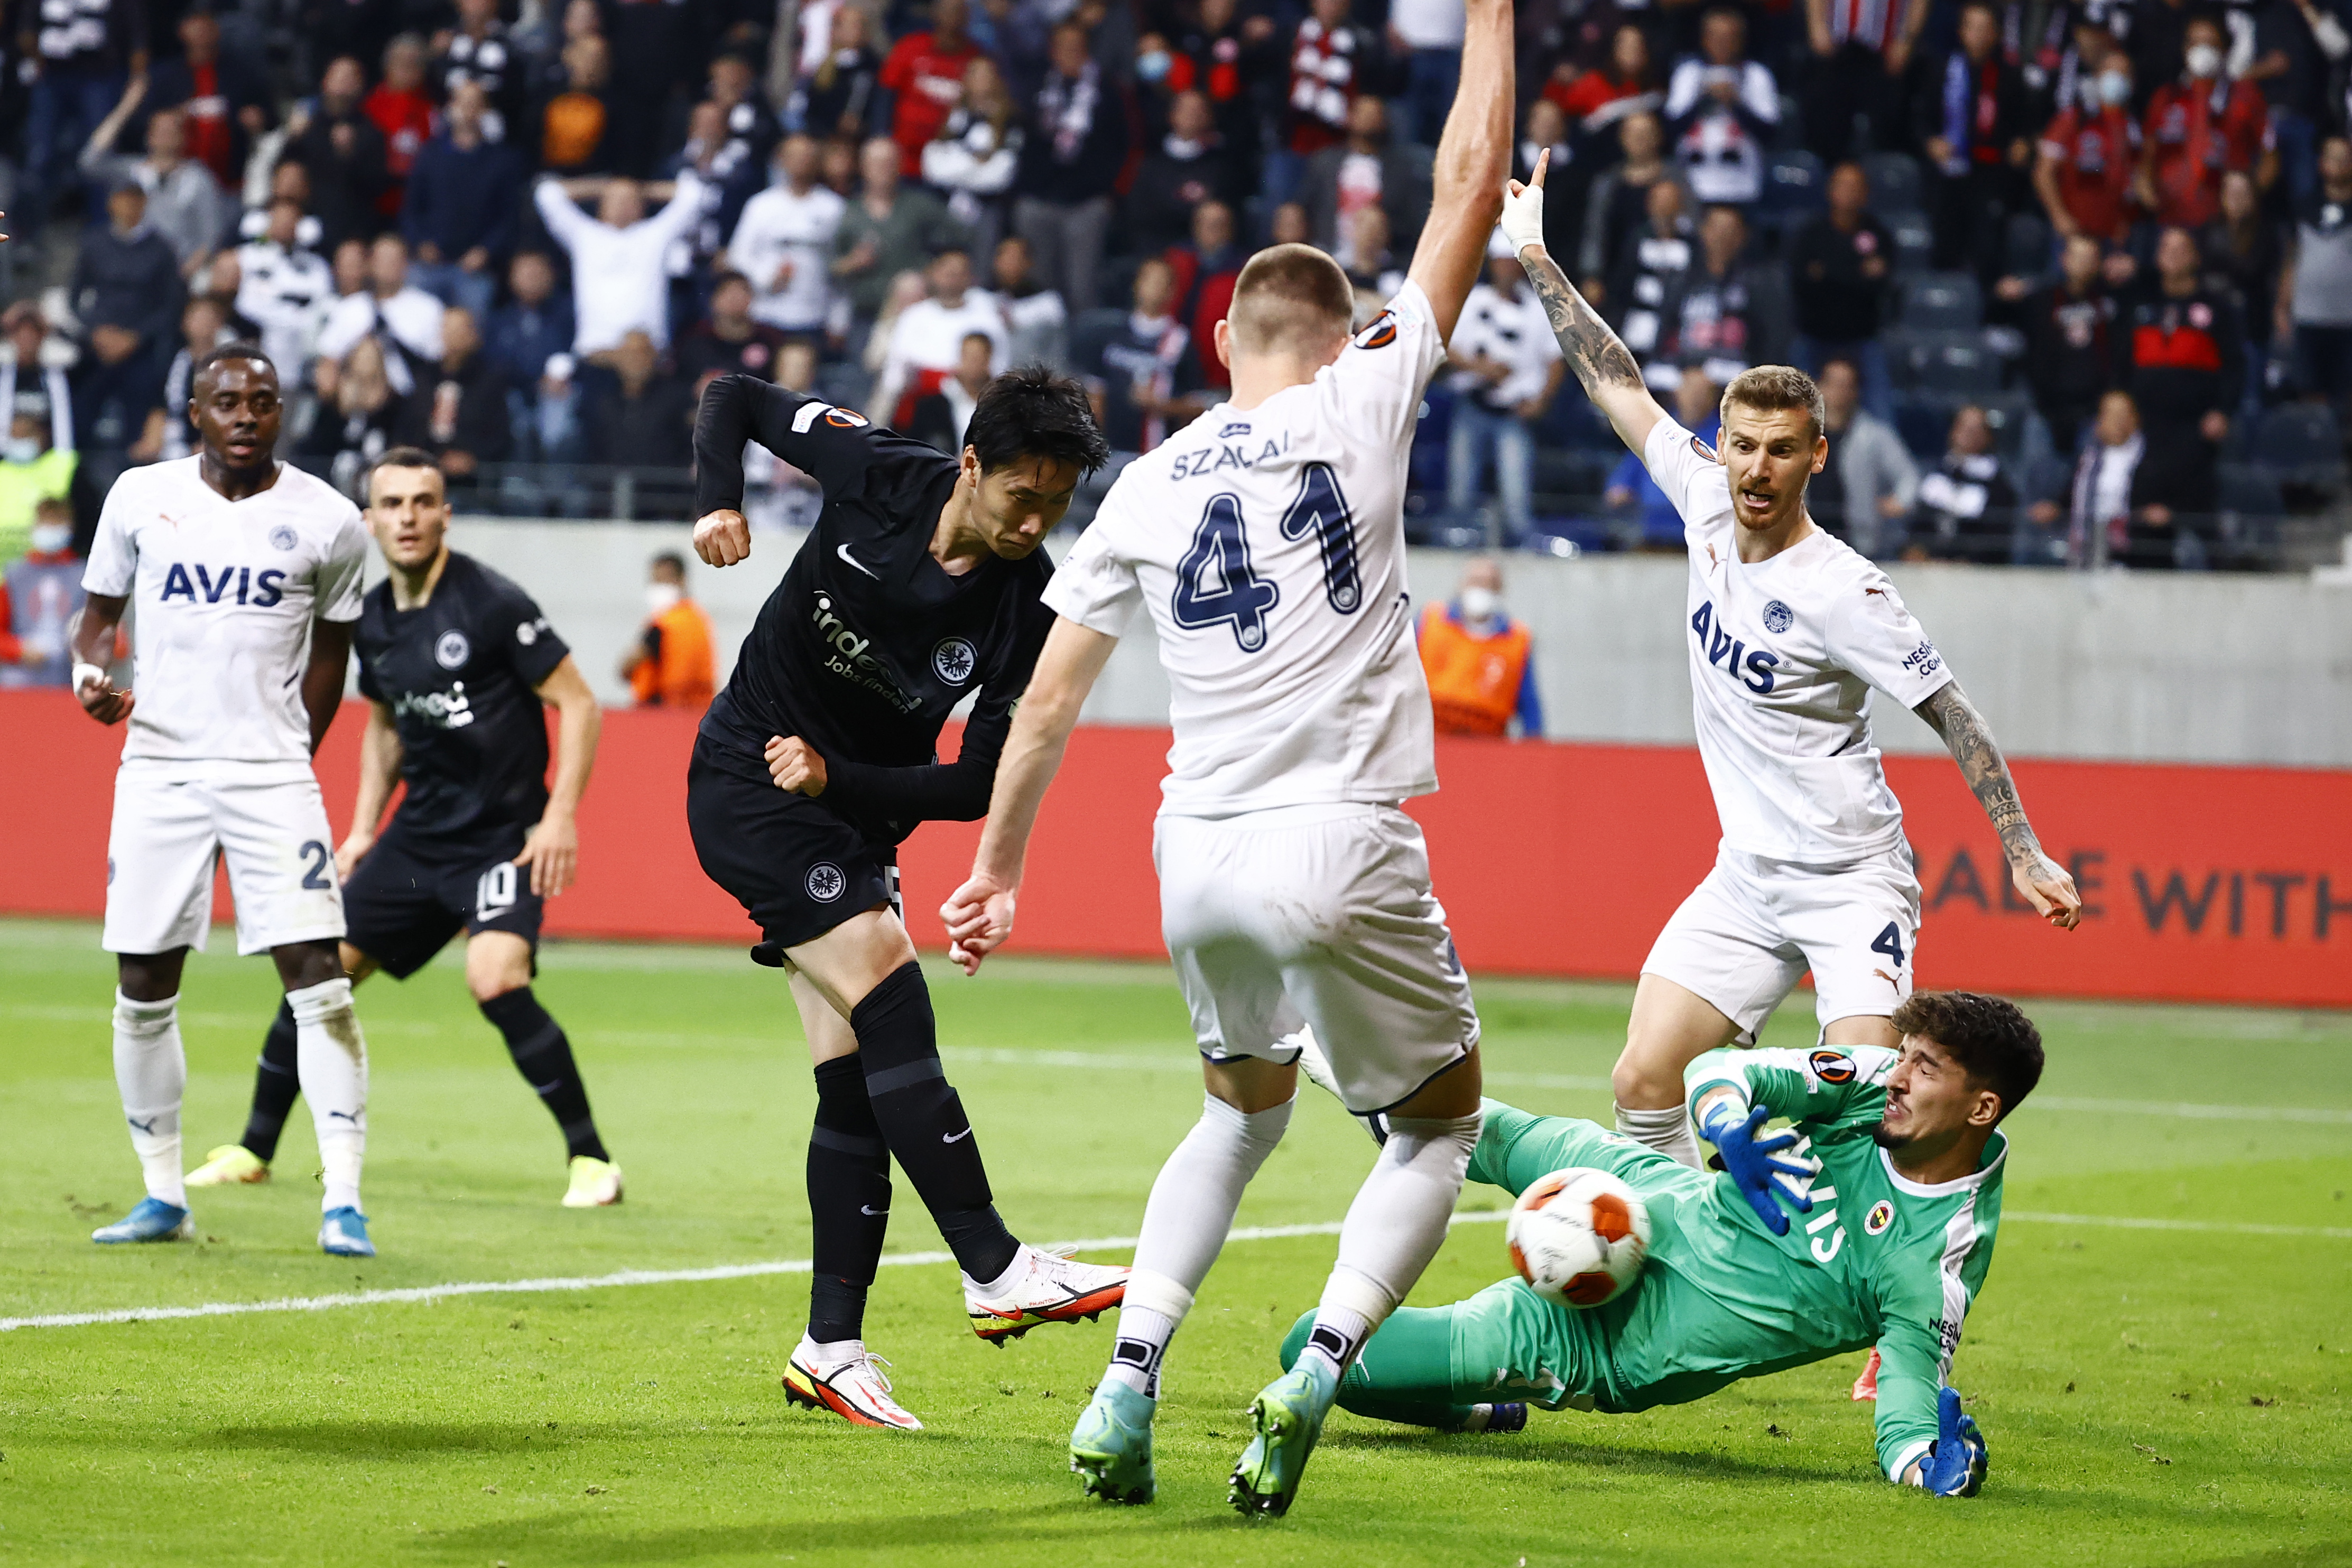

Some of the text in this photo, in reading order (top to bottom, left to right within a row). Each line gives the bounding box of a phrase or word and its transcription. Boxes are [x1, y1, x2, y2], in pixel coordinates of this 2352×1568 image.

[160, 562, 287, 607] AVIS
[1172, 461, 1362, 653] 41
[1692, 599, 1780, 694] AVIS
[824, 655, 909, 714] Jobs finden
[476, 861, 517, 911] 10
[1912, 846, 2352, 941] ALE WITH
[1871, 921, 1905, 968] 4
